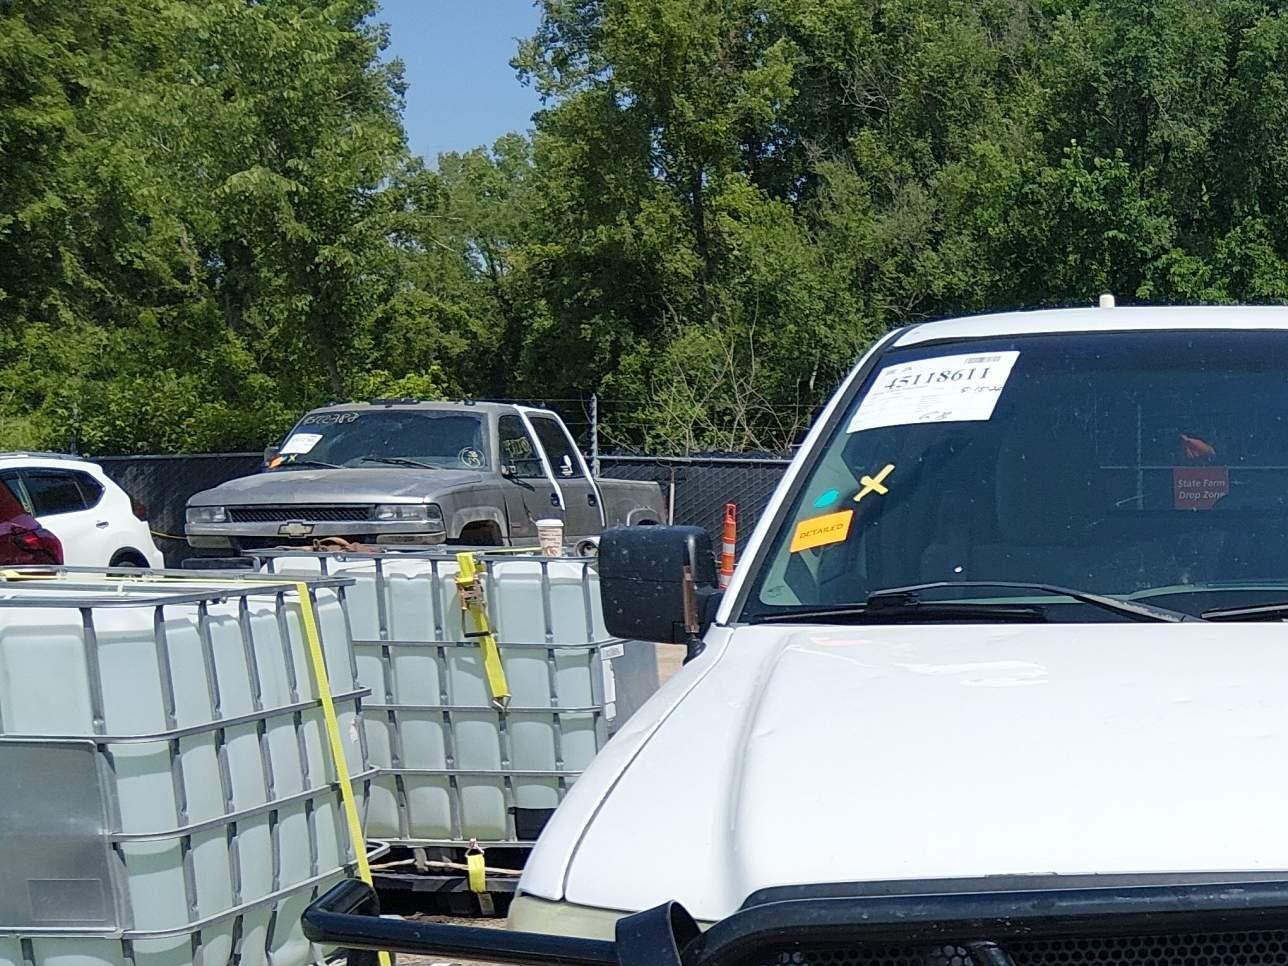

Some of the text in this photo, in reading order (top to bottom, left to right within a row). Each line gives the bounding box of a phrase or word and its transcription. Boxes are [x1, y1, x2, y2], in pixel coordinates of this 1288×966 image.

[884, 366, 990, 390] 45118611
[1177, 479, 1225, 489] State Farm
[1179, 491, 1201, 501] Drop
